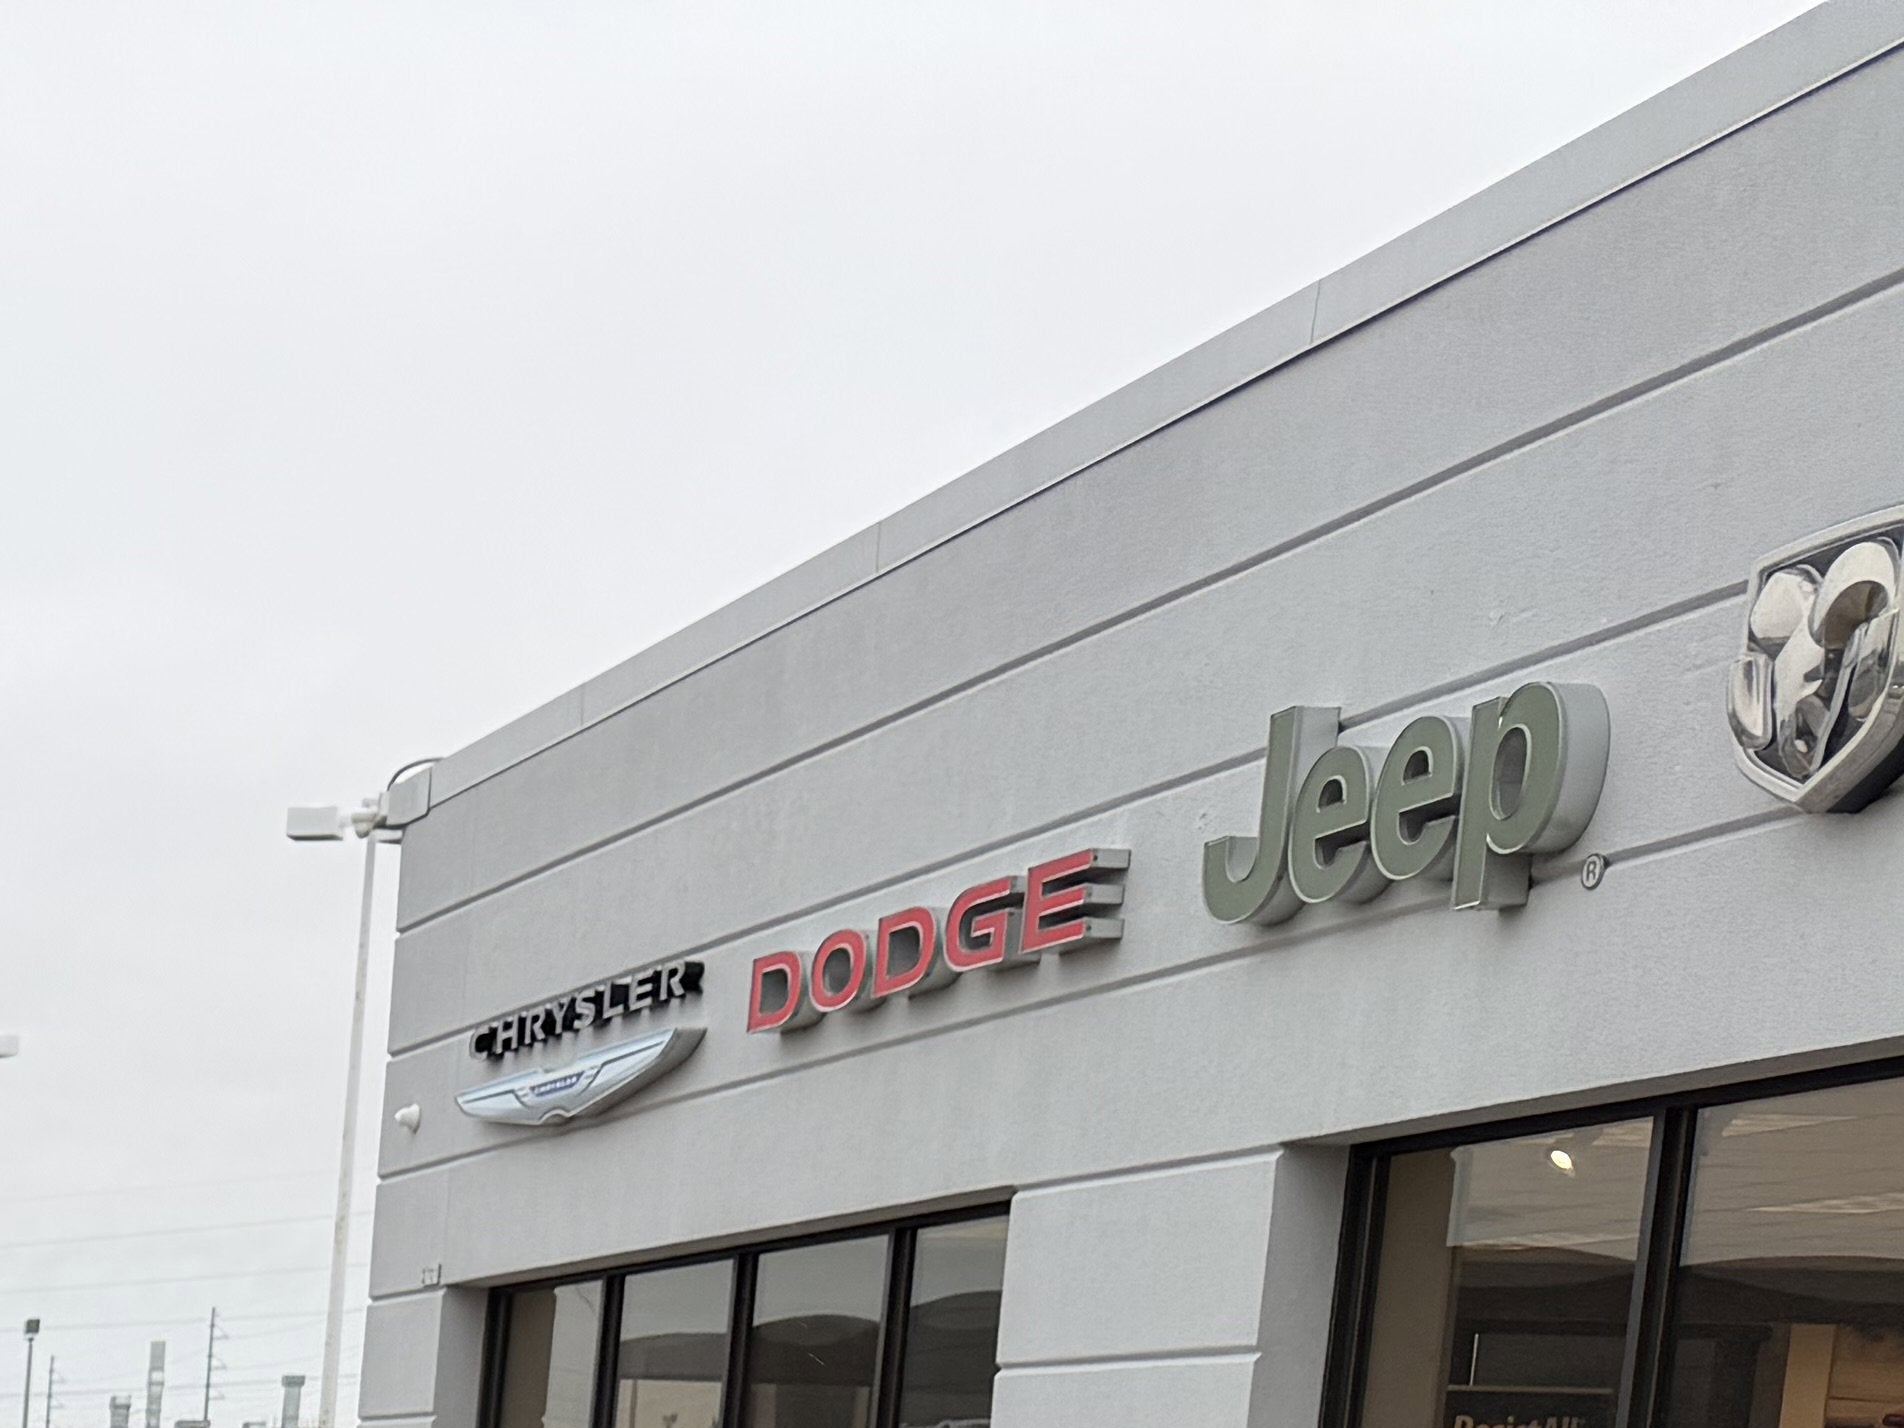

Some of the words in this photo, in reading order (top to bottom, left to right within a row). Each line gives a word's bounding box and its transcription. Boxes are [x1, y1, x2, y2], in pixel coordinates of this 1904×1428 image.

[1202, 681, 1592, 925] Jeep
[469, 959, 694, 1062] CHRYSLER
[746, 847, 1104, 1034] DODGE
